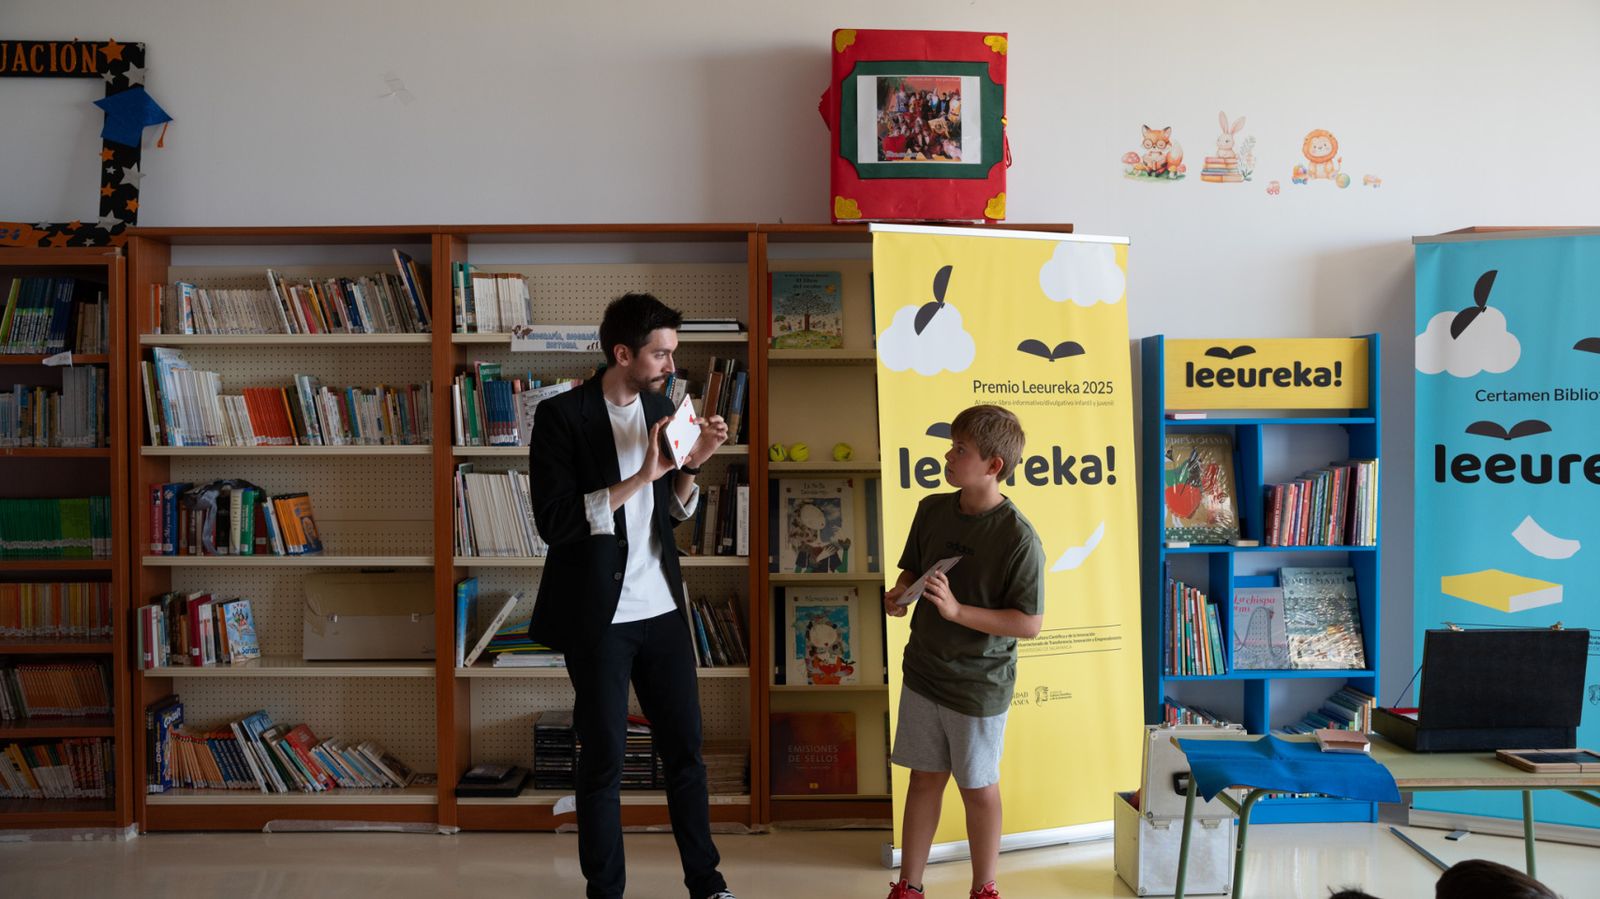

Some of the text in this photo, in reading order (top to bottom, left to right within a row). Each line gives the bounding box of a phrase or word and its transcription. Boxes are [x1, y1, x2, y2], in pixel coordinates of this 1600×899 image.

[1185, 361, 1342, 388] leeureka!
[973, 380, 1114, 395] Premio Leeureka 2025
[1475, 388, 1550, 402] Certamen
[788, 744, 840, 753] EMISIONES
[788, 754, 840, 763] DE SELLOS
